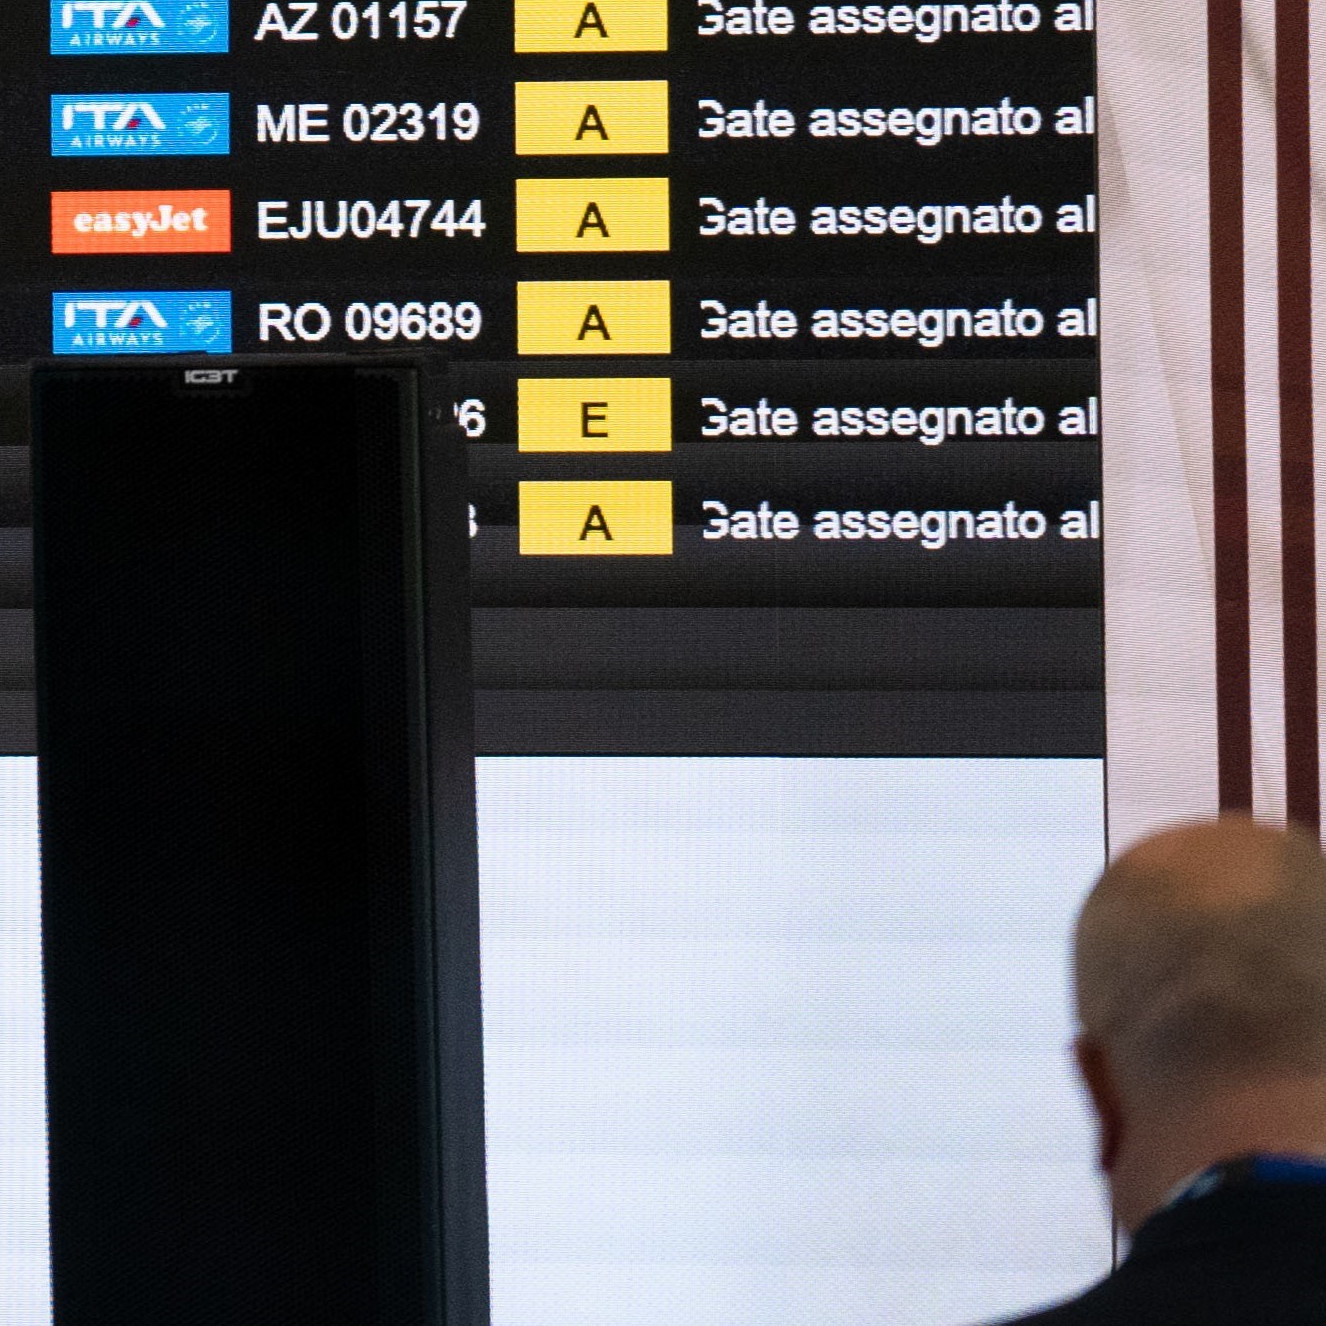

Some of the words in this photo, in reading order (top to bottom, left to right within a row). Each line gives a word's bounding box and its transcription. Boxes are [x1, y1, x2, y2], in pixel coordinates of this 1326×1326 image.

[254, 3, 318, 40] AZ
[332, 1, 467, 39] 01157
[257, 104, 330, 142] ME
[343, 103, 479, 141] 02319
[258, 200, 486, 239] EJU04744
[260, 303, 331, 341] RO
[345, 302, 481, 340] 09689
